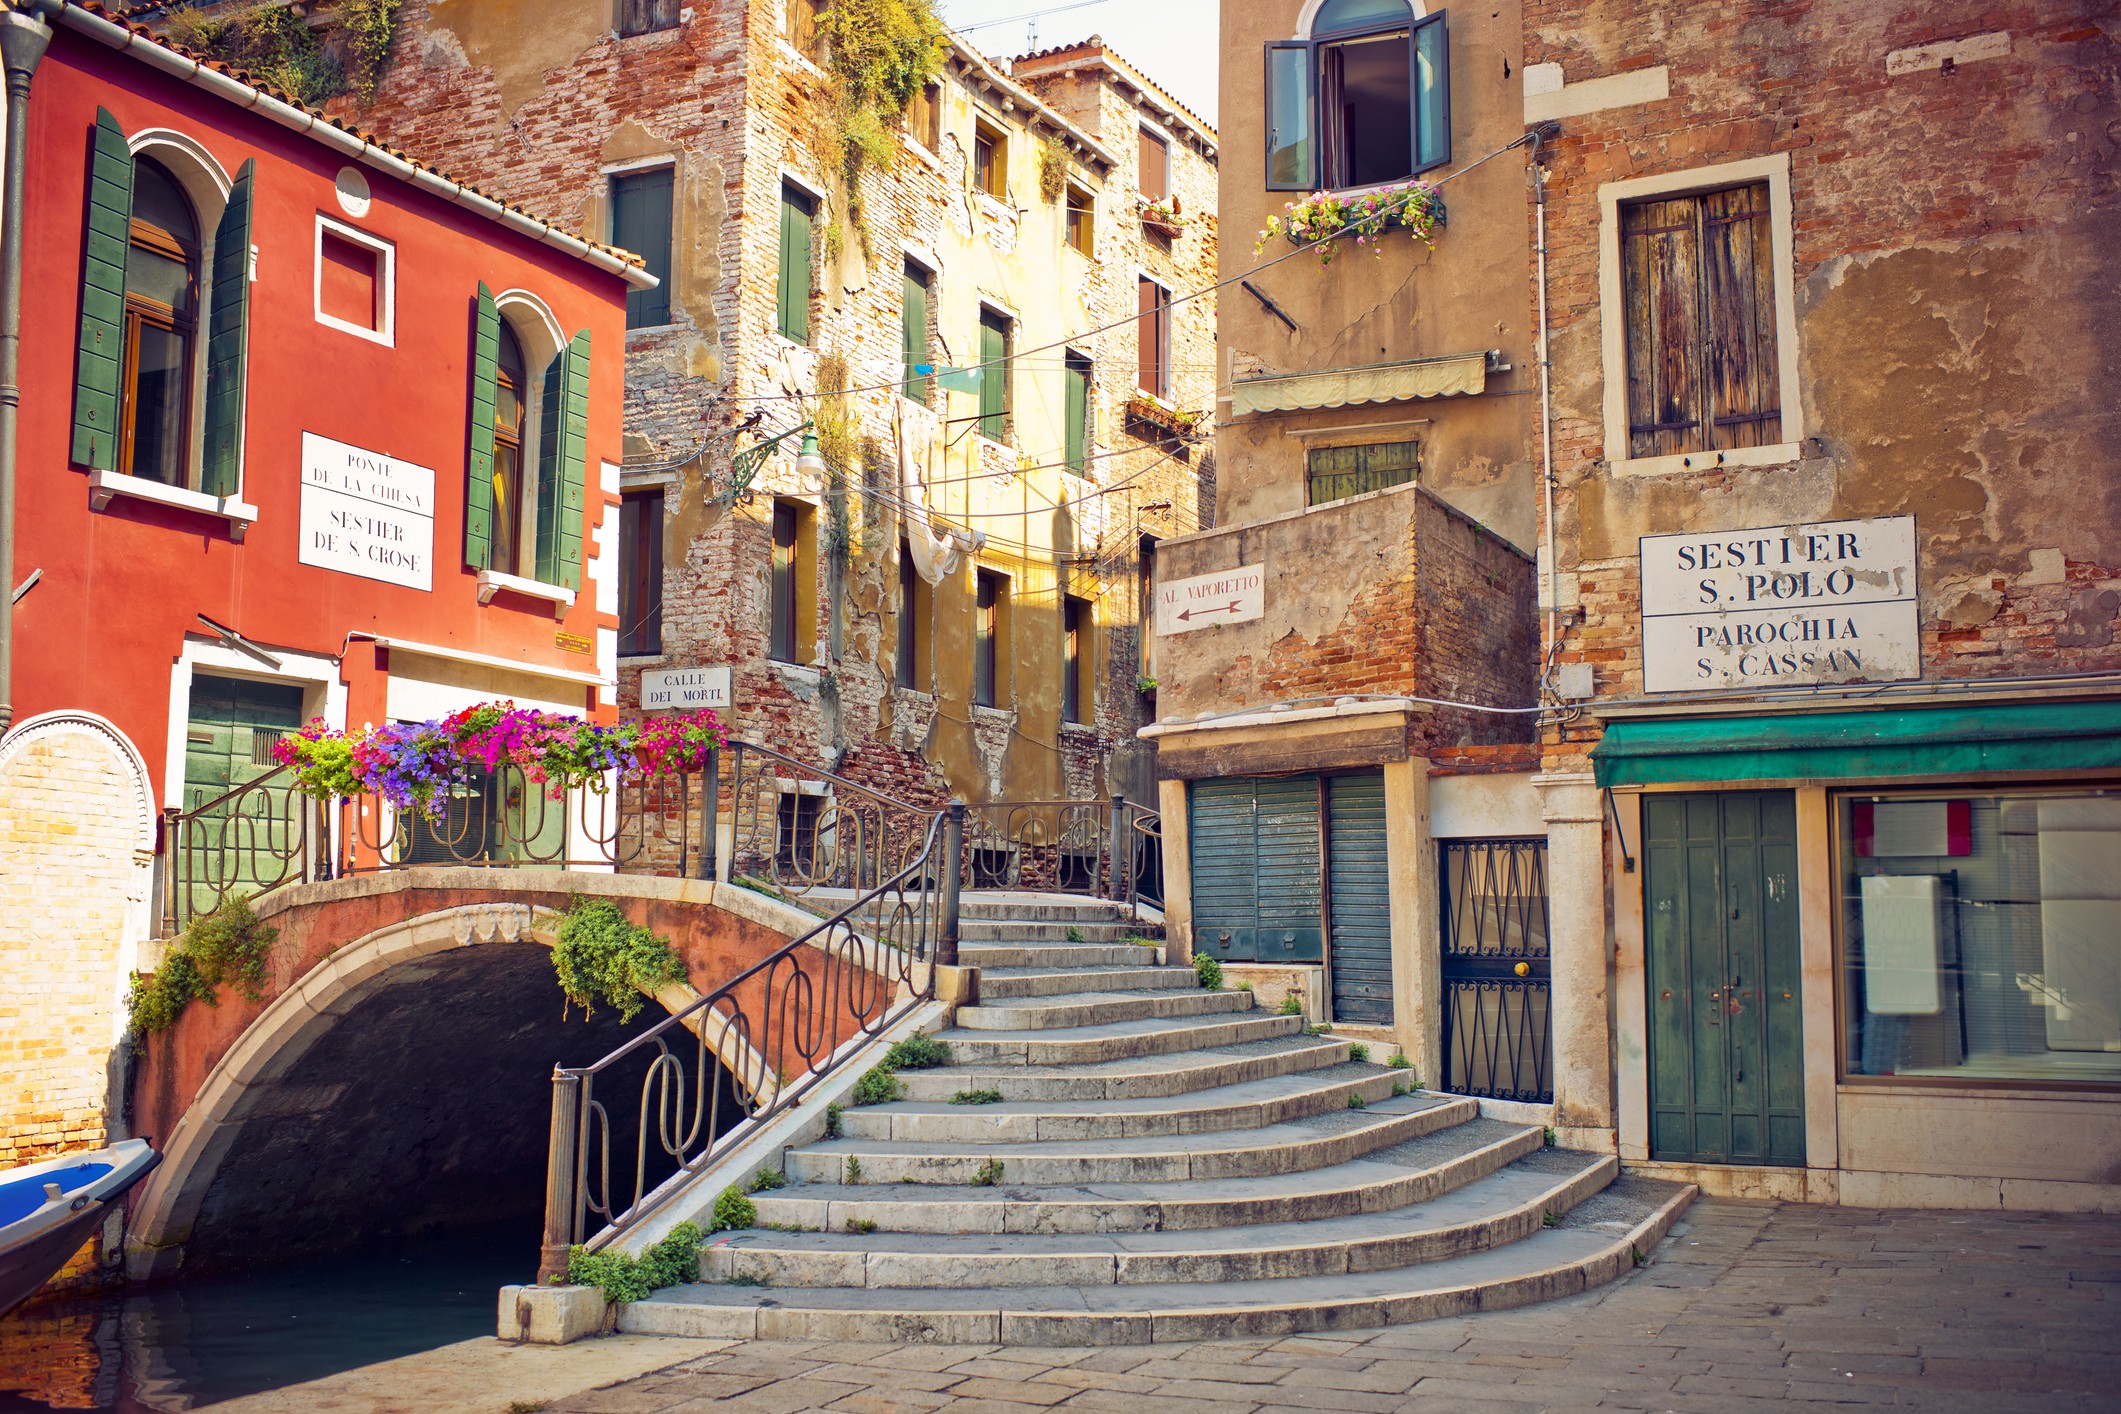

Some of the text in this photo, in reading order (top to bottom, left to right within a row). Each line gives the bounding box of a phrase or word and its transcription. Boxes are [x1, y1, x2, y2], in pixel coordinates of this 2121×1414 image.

[348, 454, 393, 478] PONTE
[314, 467, 421, 508] DE LA CHIESA
[330, 509, 403, 543] SESTIER
[314, 531, 339, 553] DE
[368, 544, 421, 573] CROSE
[1678, 533, 1861, 571] SESTIER
[1163, 575, 1259, 605] AL VAPORETTO
[1696, 617, 1859, 648] PAROCHIA
[664, 673, 706, 686] CALLE
[650, 691, 671, 703] DEI
